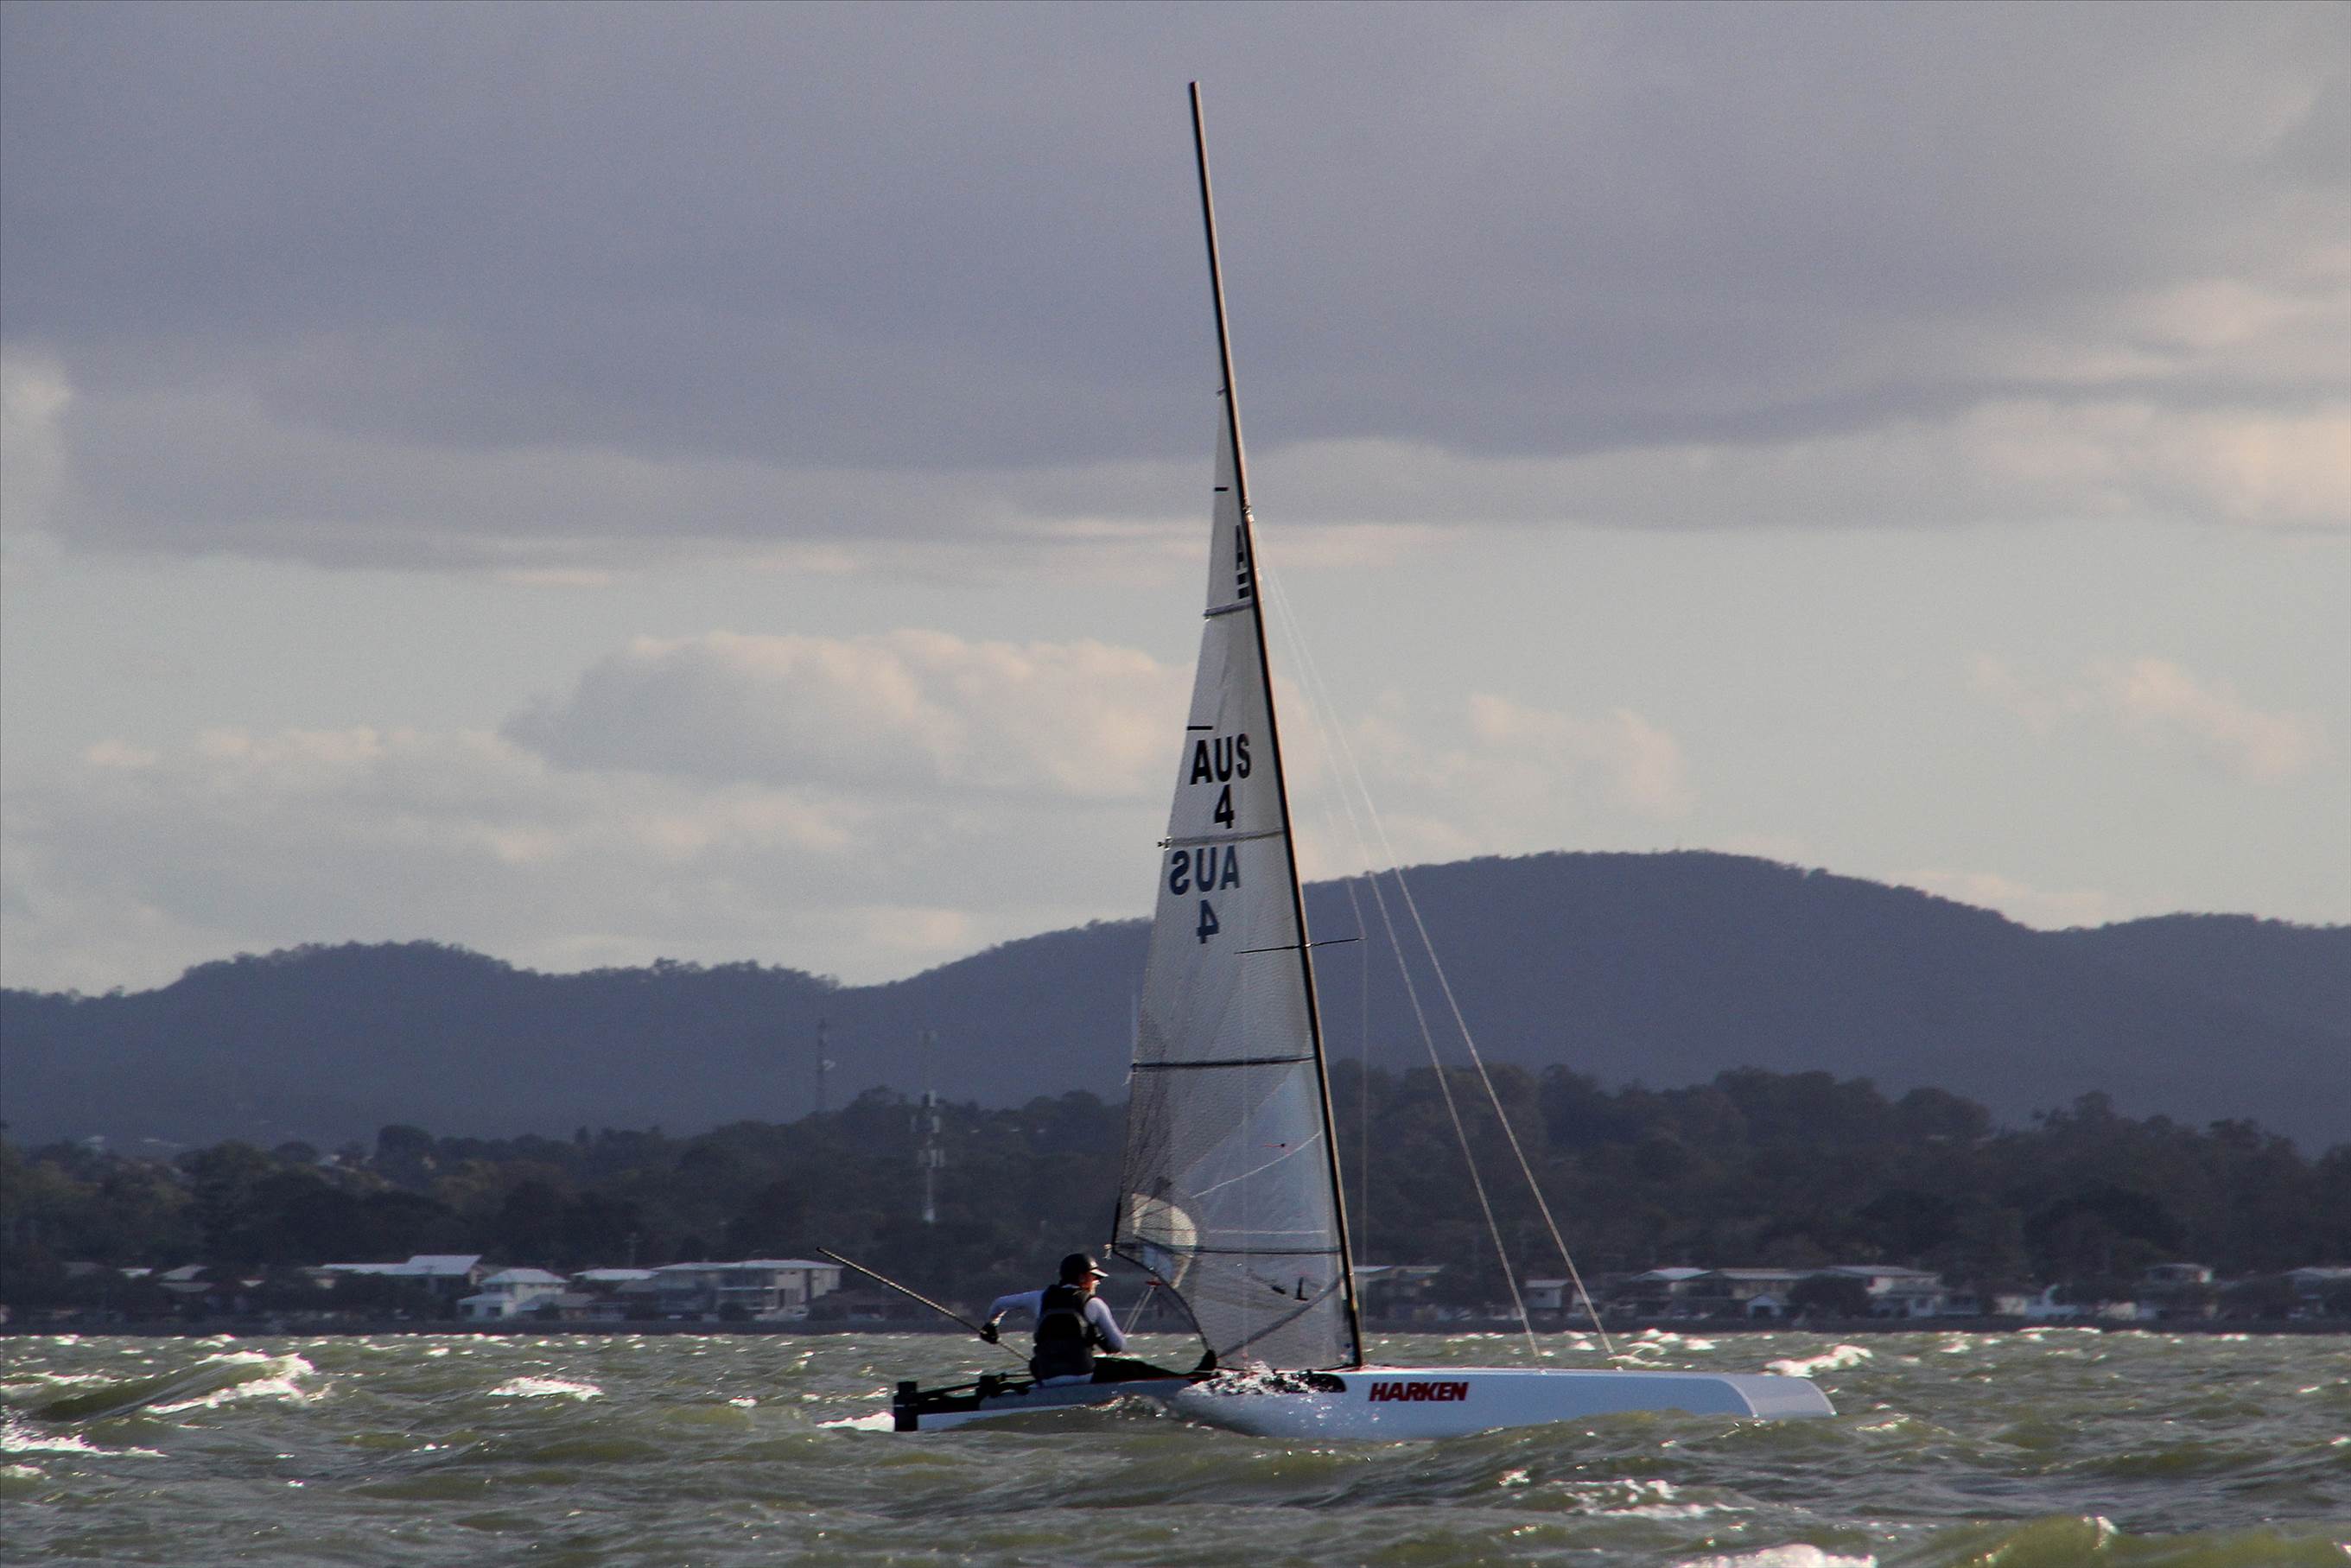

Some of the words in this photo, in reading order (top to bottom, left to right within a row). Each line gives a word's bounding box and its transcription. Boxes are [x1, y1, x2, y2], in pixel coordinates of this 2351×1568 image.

[1190, 733, 1250, 784] AUS
[1214, 784, 1235, 829] 4
[1369, 1382, 1469, 1401] HARKEN
